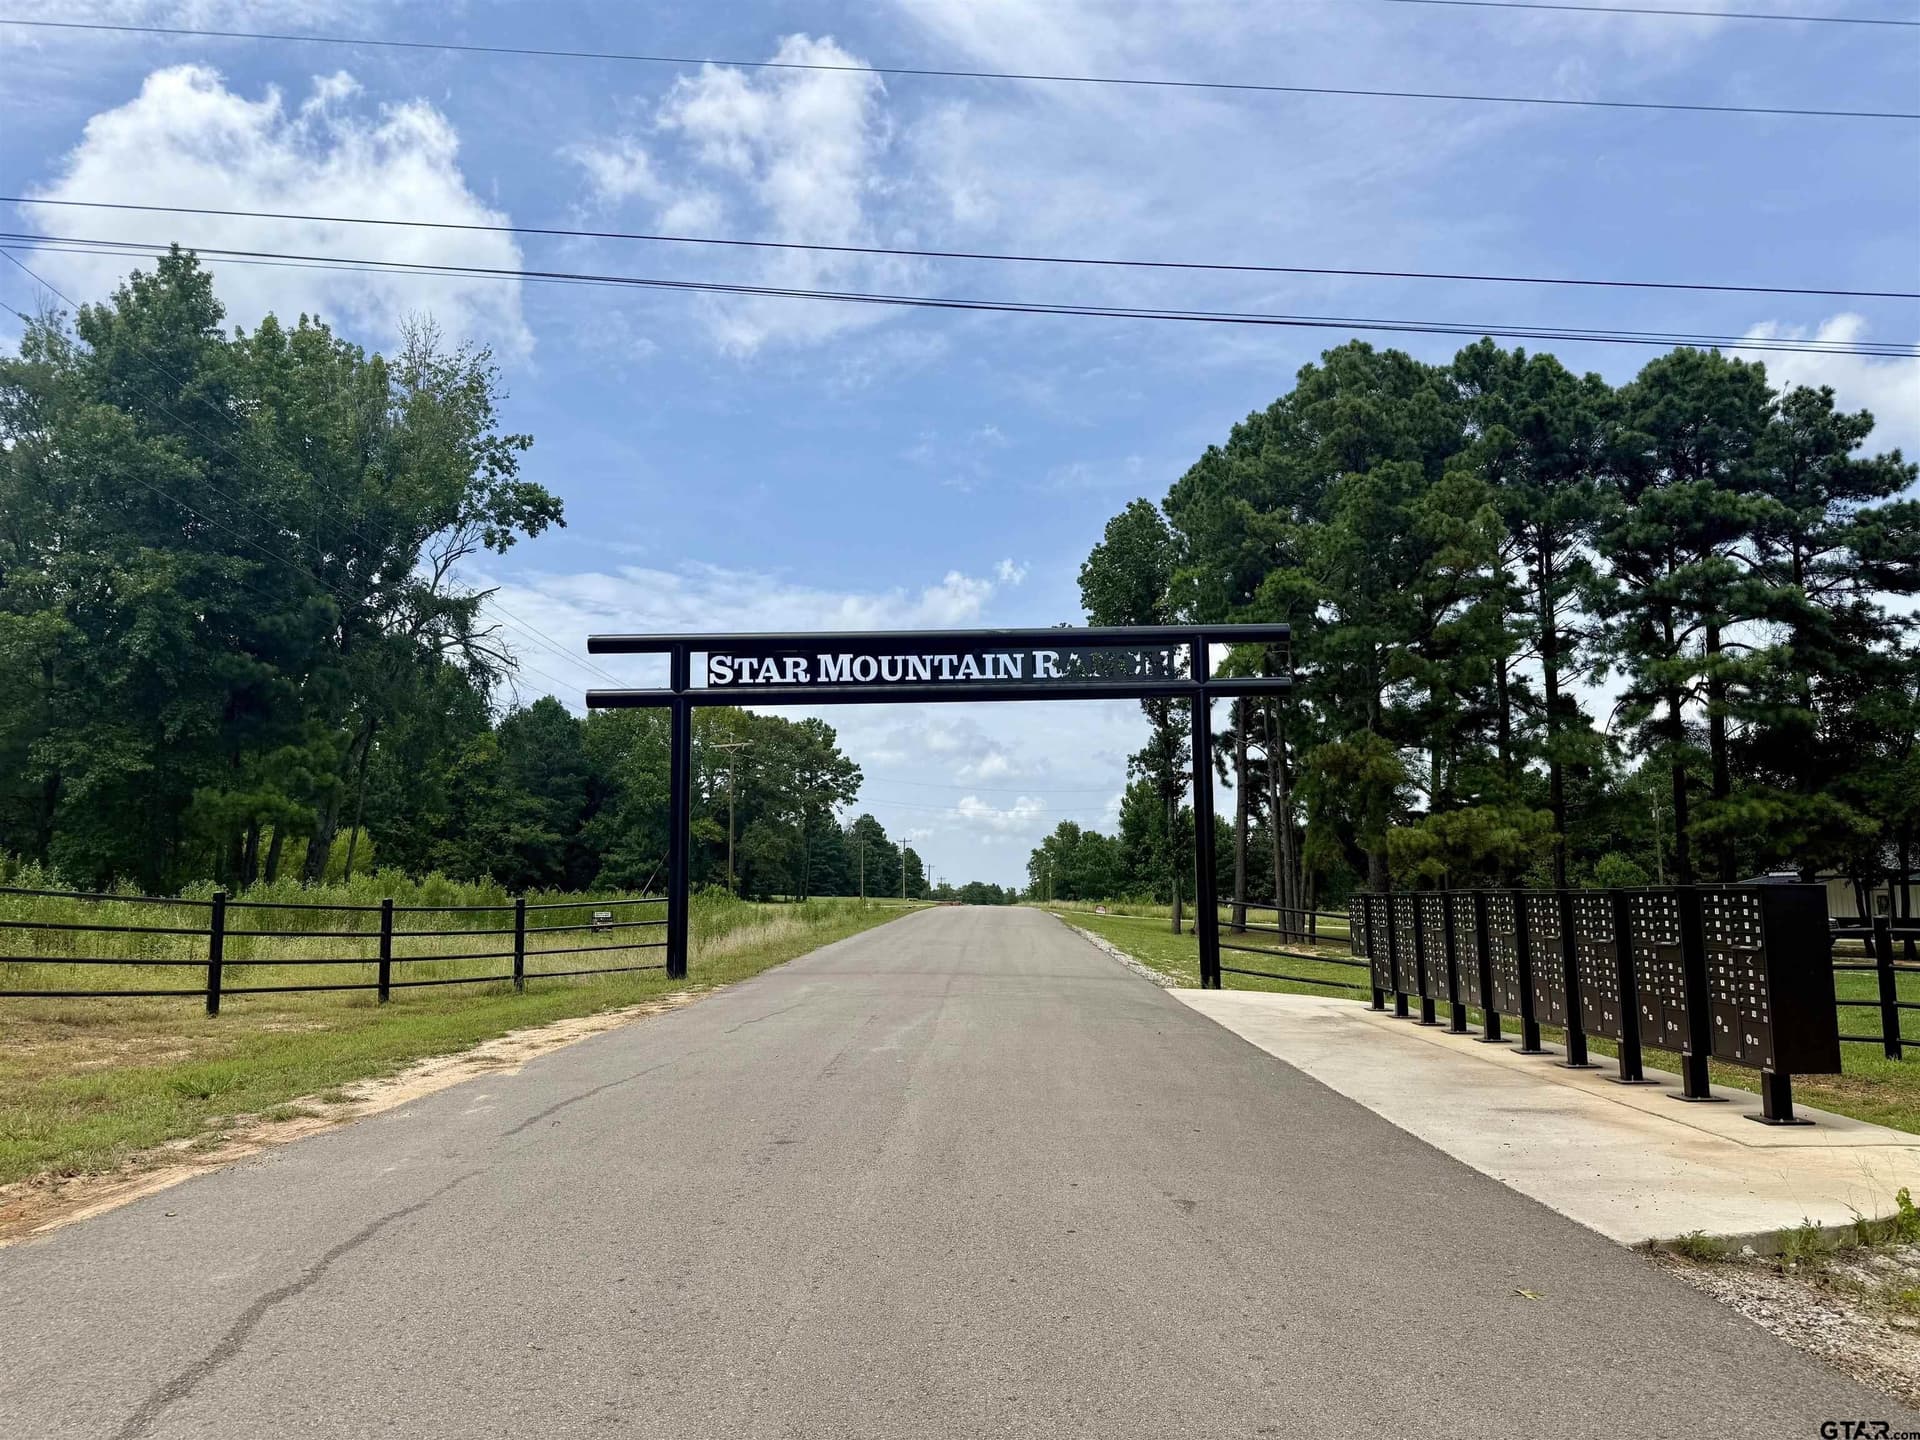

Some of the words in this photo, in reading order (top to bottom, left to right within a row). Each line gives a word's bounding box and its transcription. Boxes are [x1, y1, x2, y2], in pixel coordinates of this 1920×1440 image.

[709, 655, 811, 685] STAR
[816, 652, 1025, 682] MOUNTAIN
[1032, 650, 1173, 679] RACH
